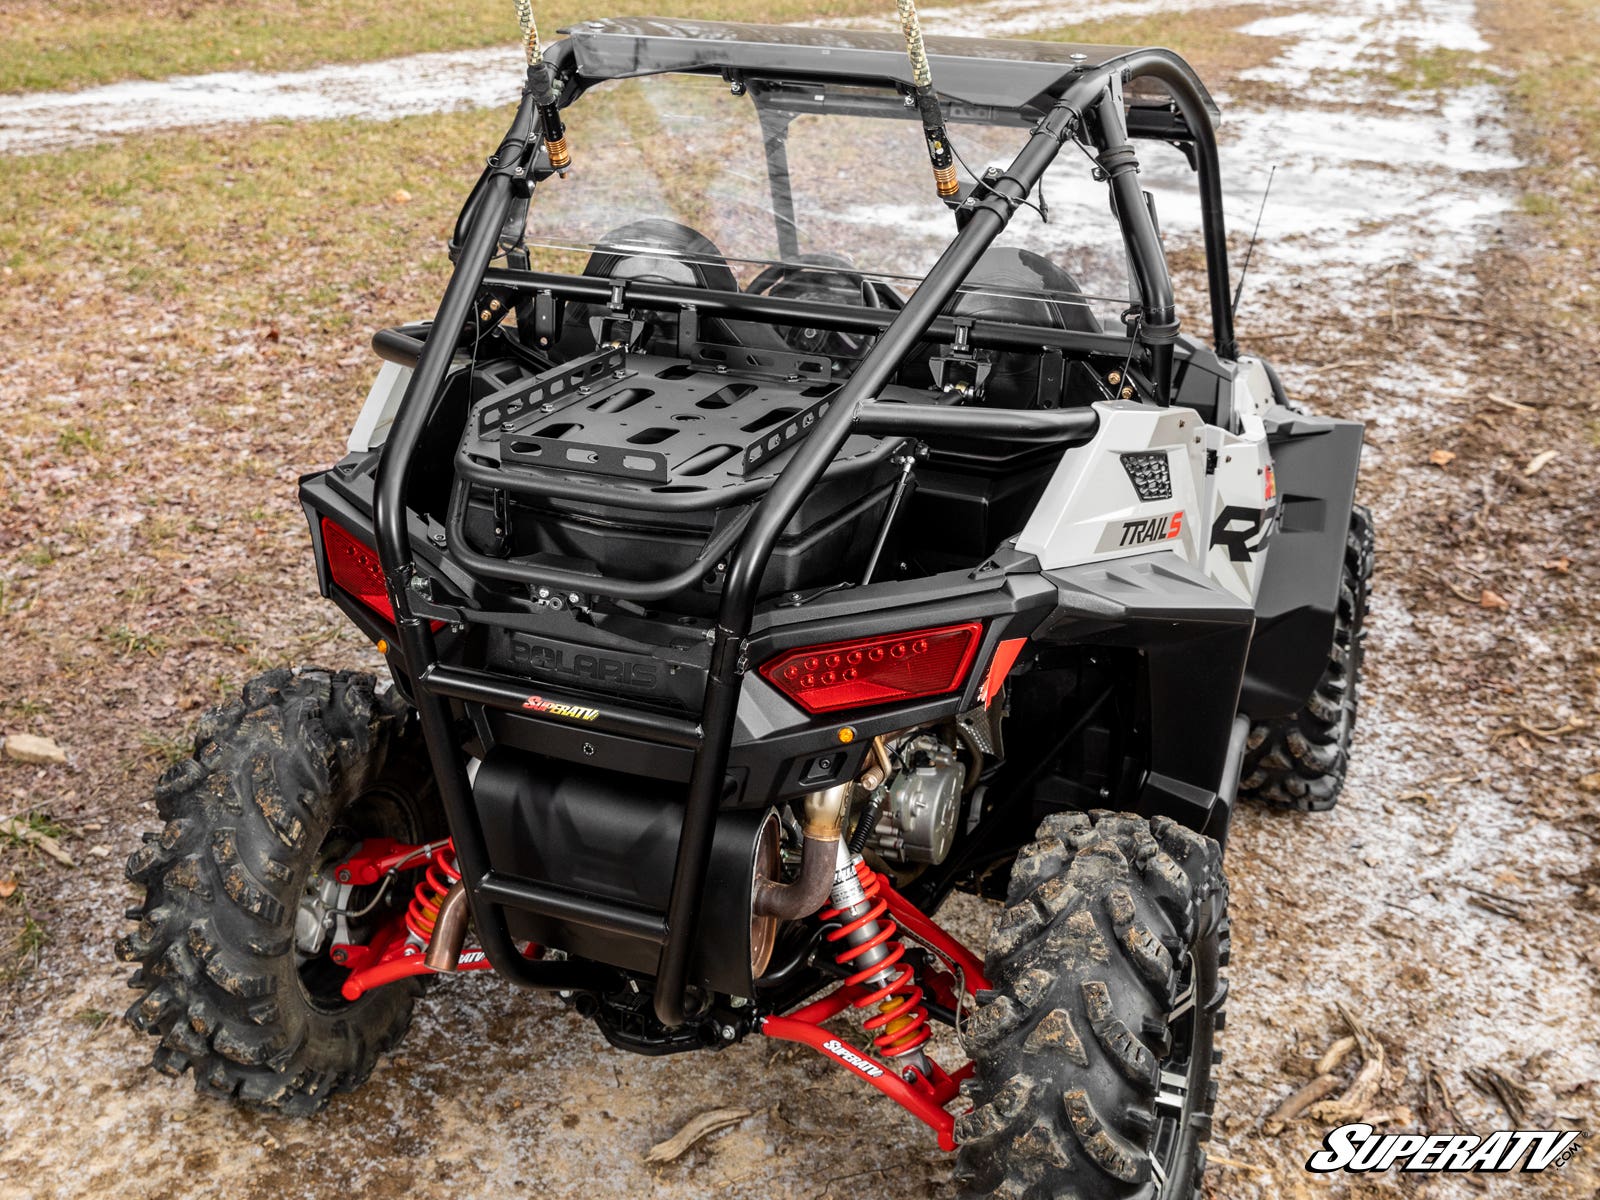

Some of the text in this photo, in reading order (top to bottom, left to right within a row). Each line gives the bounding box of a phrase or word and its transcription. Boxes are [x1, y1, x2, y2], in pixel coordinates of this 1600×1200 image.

[510, 640, 657, 689] POLARIS
[522, 696, 600, 720] SUPERATV
[823, 1040, 884, 1078] SUPERATV
